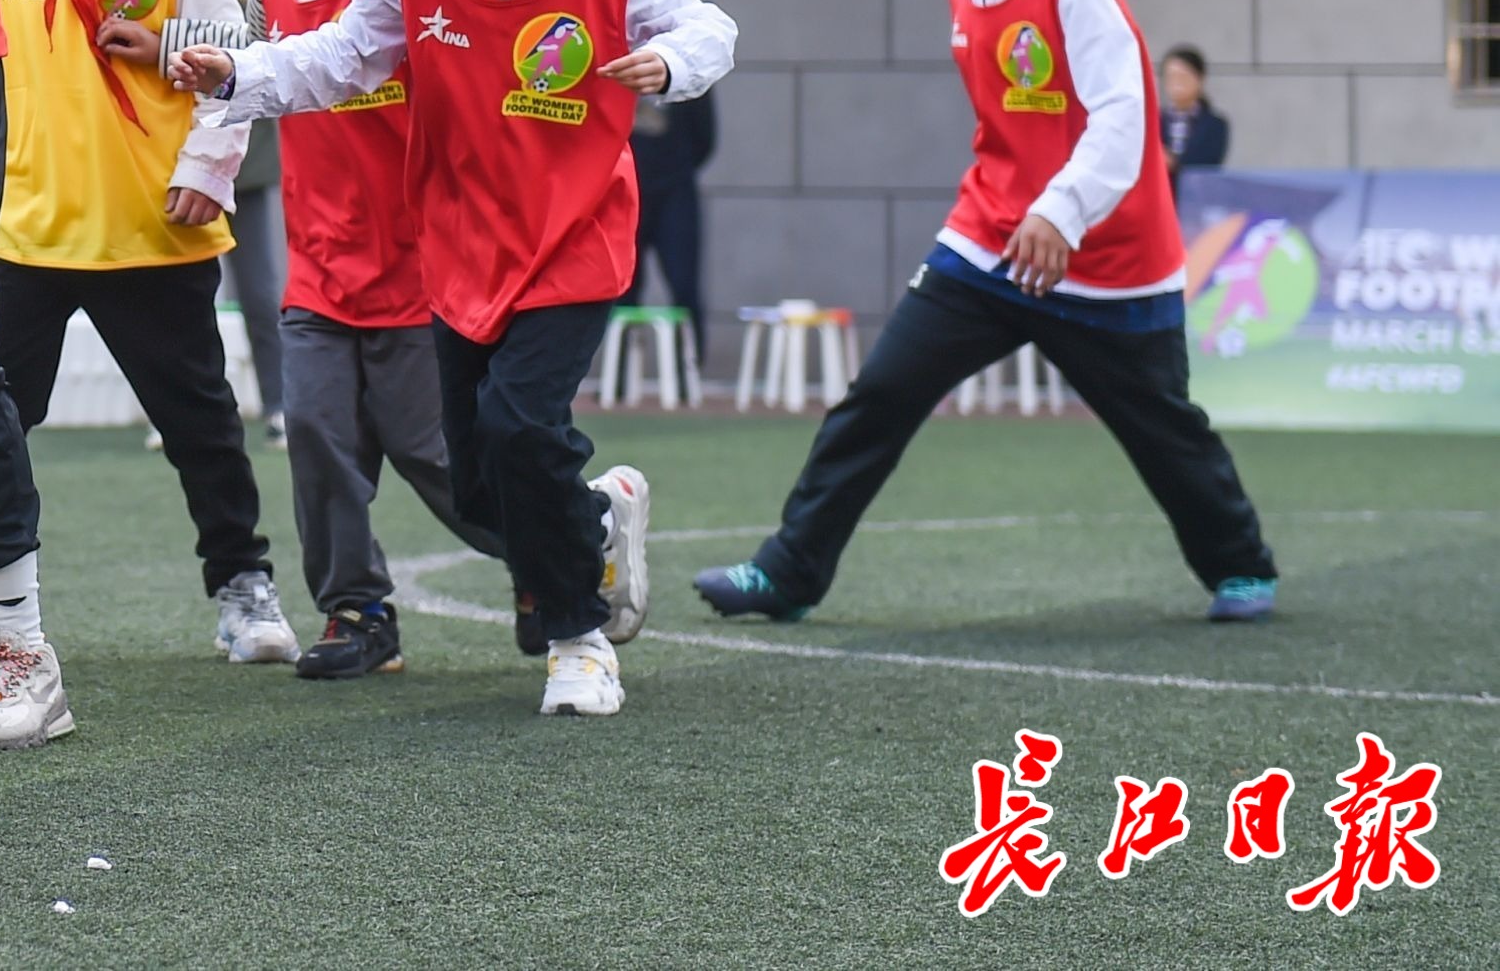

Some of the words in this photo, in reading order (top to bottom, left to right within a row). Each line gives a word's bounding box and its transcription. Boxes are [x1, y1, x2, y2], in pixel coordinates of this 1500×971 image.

[506, 104, 559, 118] FOOTBALL
[561, 111, 582, 121] DAY
[532, 97, 584, 113] WOMEN'S
[1332, 319, 1454, 353] MARCH
